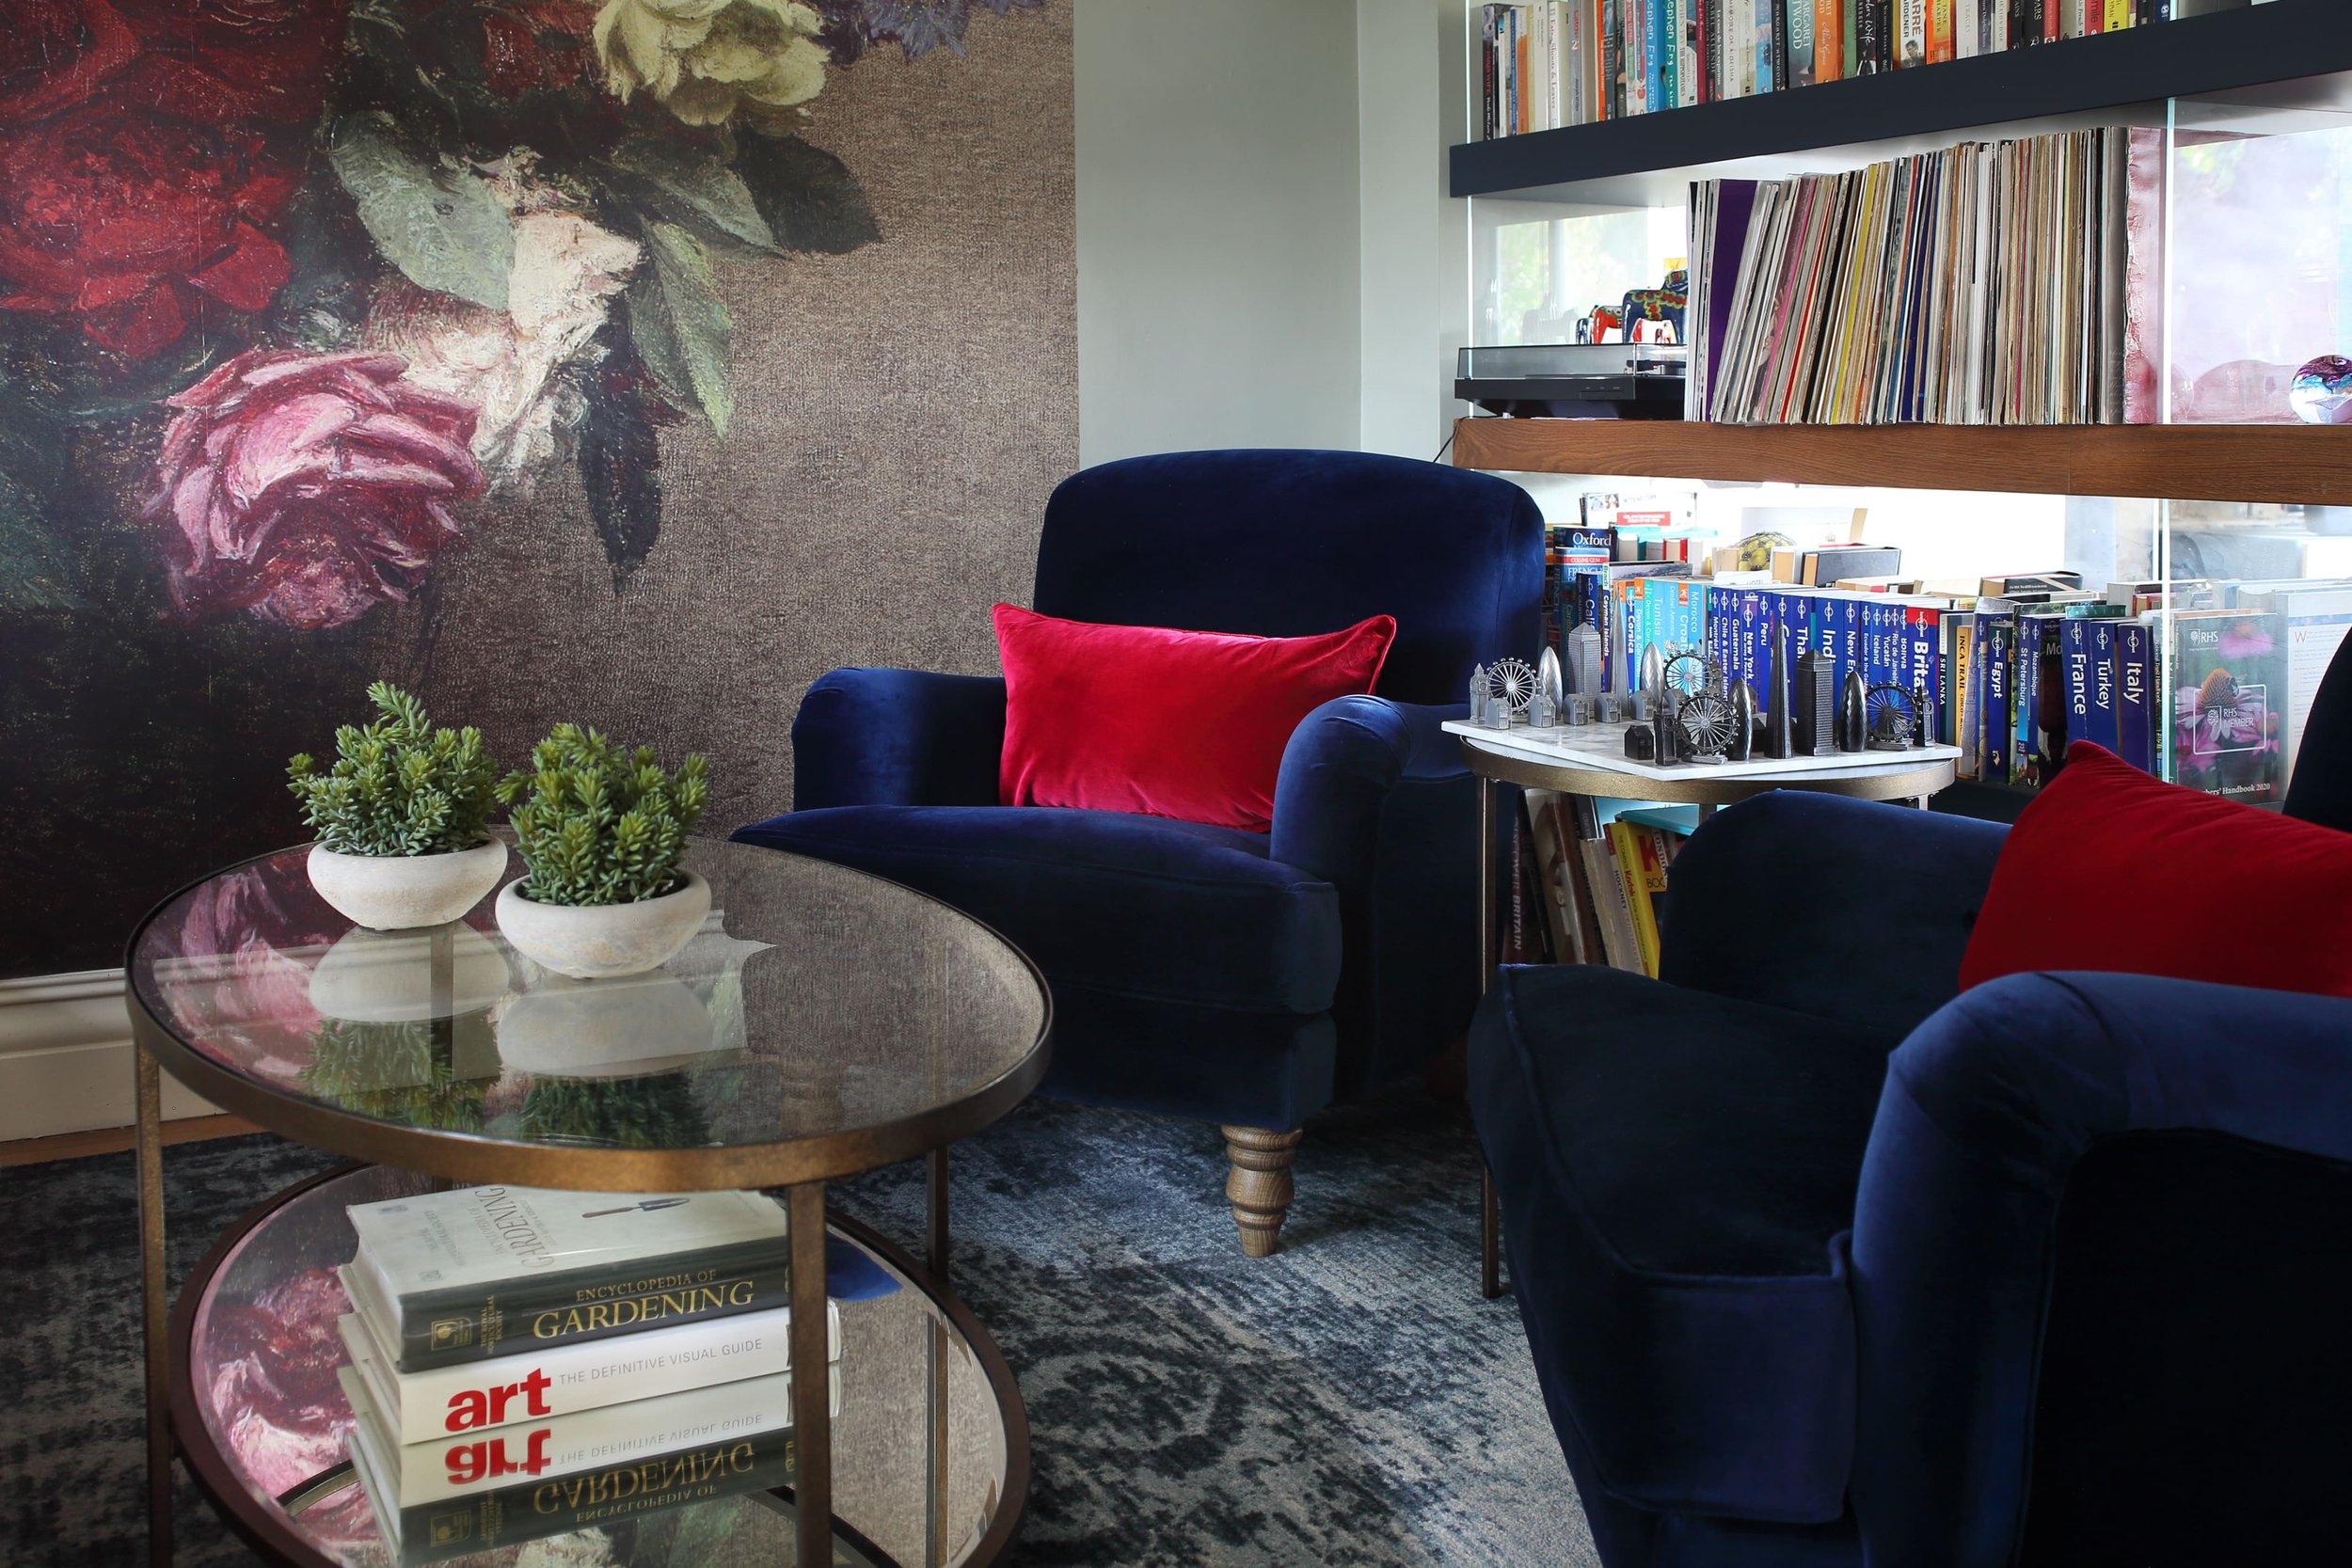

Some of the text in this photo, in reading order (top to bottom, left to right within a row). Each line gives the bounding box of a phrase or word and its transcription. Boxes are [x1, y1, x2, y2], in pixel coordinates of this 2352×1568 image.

[2090, 0, 2100, 23] mile
[1646, 0, 1656, 66] ephen Fry
[1666, 0, 1676, 65] ephen Fry
[1860, 20, 1876, 46] Wife
[1572, 532, 1612, 546] Oxford
[1655, 597, 1663, 636] Tunisia
[1691, 591, 1699, 633] Morocco
[1760, 622, 1769, 646] Peru
[1847, 630, 1855, 657] New
[1892, 647, 1899, 657] de
[2045, 642, 2062, 656] Mo
[2201, 630, 2218, 643] RHS
[1992, 661, 2003, 699] Egypt
[2018, 647, 2028, 707] St Petersburg
[2031, 651, 2040, 697] Mozambique
[2071, 654, 2087, 715] France
[2096, 658, 2112, 710] Turkey
[2123, 661, 2143, 705] Italy
[2223, 707, 2238, 717] RHS
[2223, 717, 2254, 729] MEMBER
[2222, 783, 2271, 795] Handbook 2020
[1614, 869, 1628, 910] HOCKNEY
[1624, 869, 1636, 897] Kodak
[1512, 894, 1523, 950] BRITAIN
[474, 1187, 555, 1268] GARDENING
[576, 1270, 717, 1303] ENCYCLOPEDIA OF
[533, 1280, 755, 1339] GARDENING
[445, 1338, 763, 1433] art THE DEFINITIVE VISUAL GUIDE
